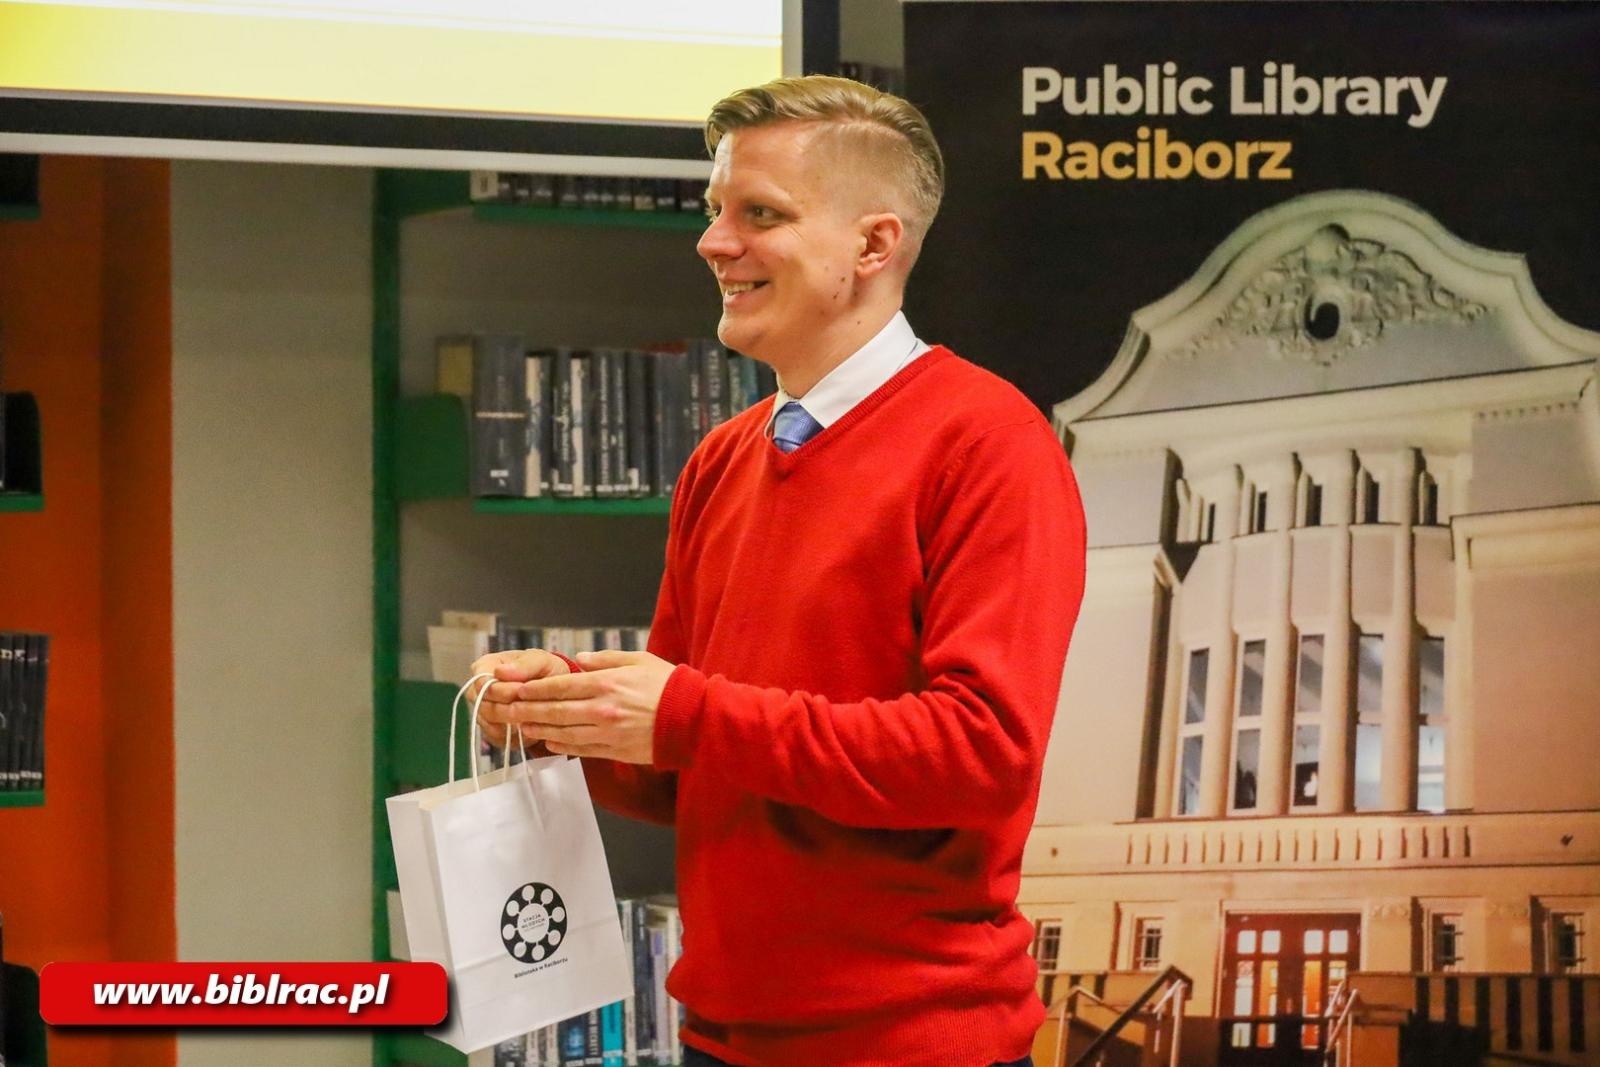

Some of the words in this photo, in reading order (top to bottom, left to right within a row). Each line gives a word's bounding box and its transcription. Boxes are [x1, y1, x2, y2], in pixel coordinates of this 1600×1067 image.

[1022, 62, 1214, 116] Public
[1230, 61, 1448, 129] Library
[1022, 128, 1293, 181] Raciborz
